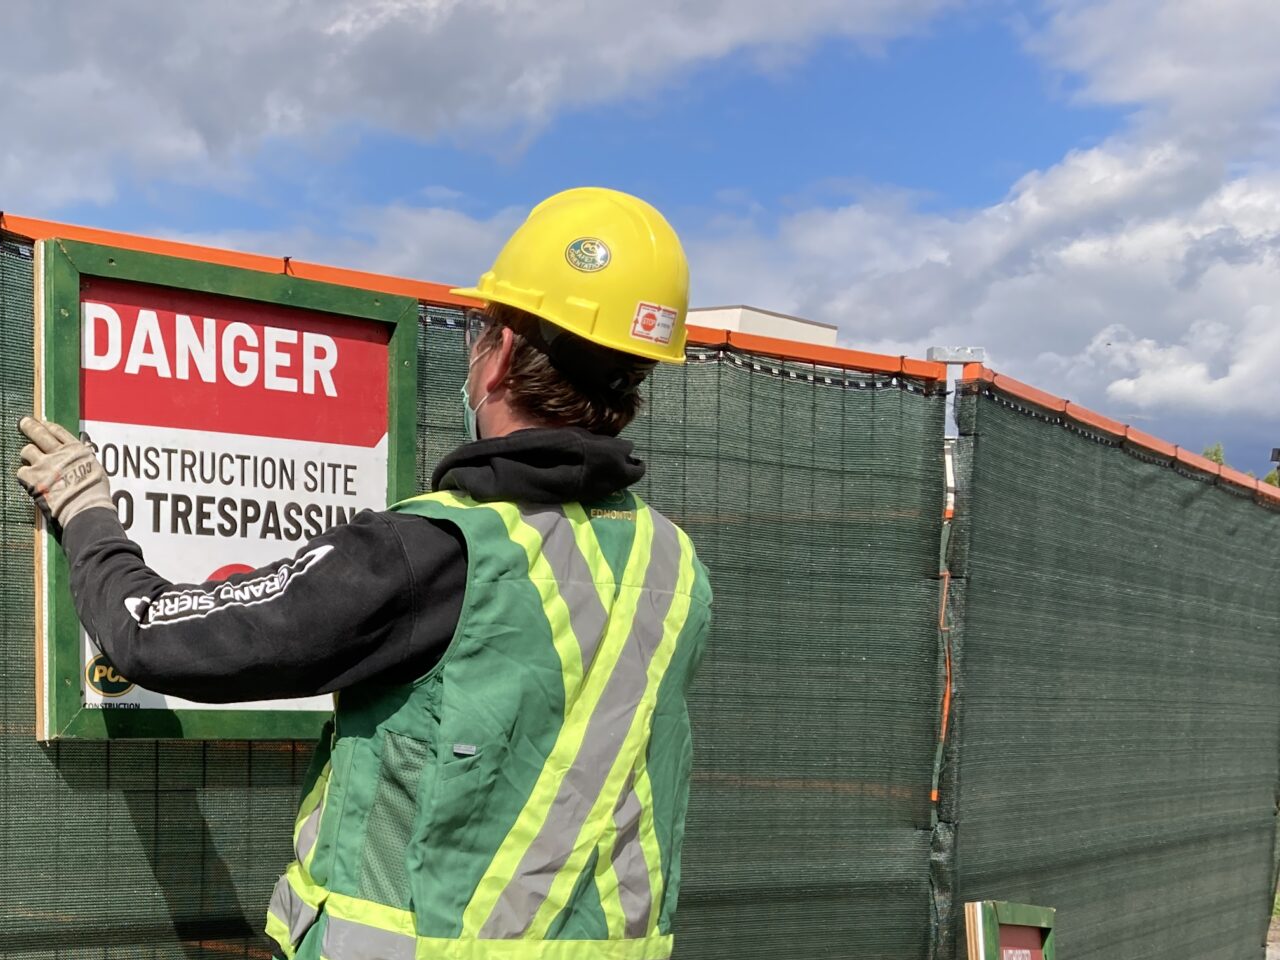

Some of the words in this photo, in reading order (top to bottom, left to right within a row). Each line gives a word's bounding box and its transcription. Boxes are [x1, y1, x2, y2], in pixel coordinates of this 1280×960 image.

[642, 317, 656, 327] STOP
[81, 301, 338, 397] DANGER
[303, 460, 357, 496] SITE
[112, 489, 134, 531] O
[145, 491, 356, 541] TRESPASSI
[590, 508, 637, 521] EDMONTO
[220, 567, 289, 602] GRAND
[83, 702, 140, 710] CONSTRUCTION
